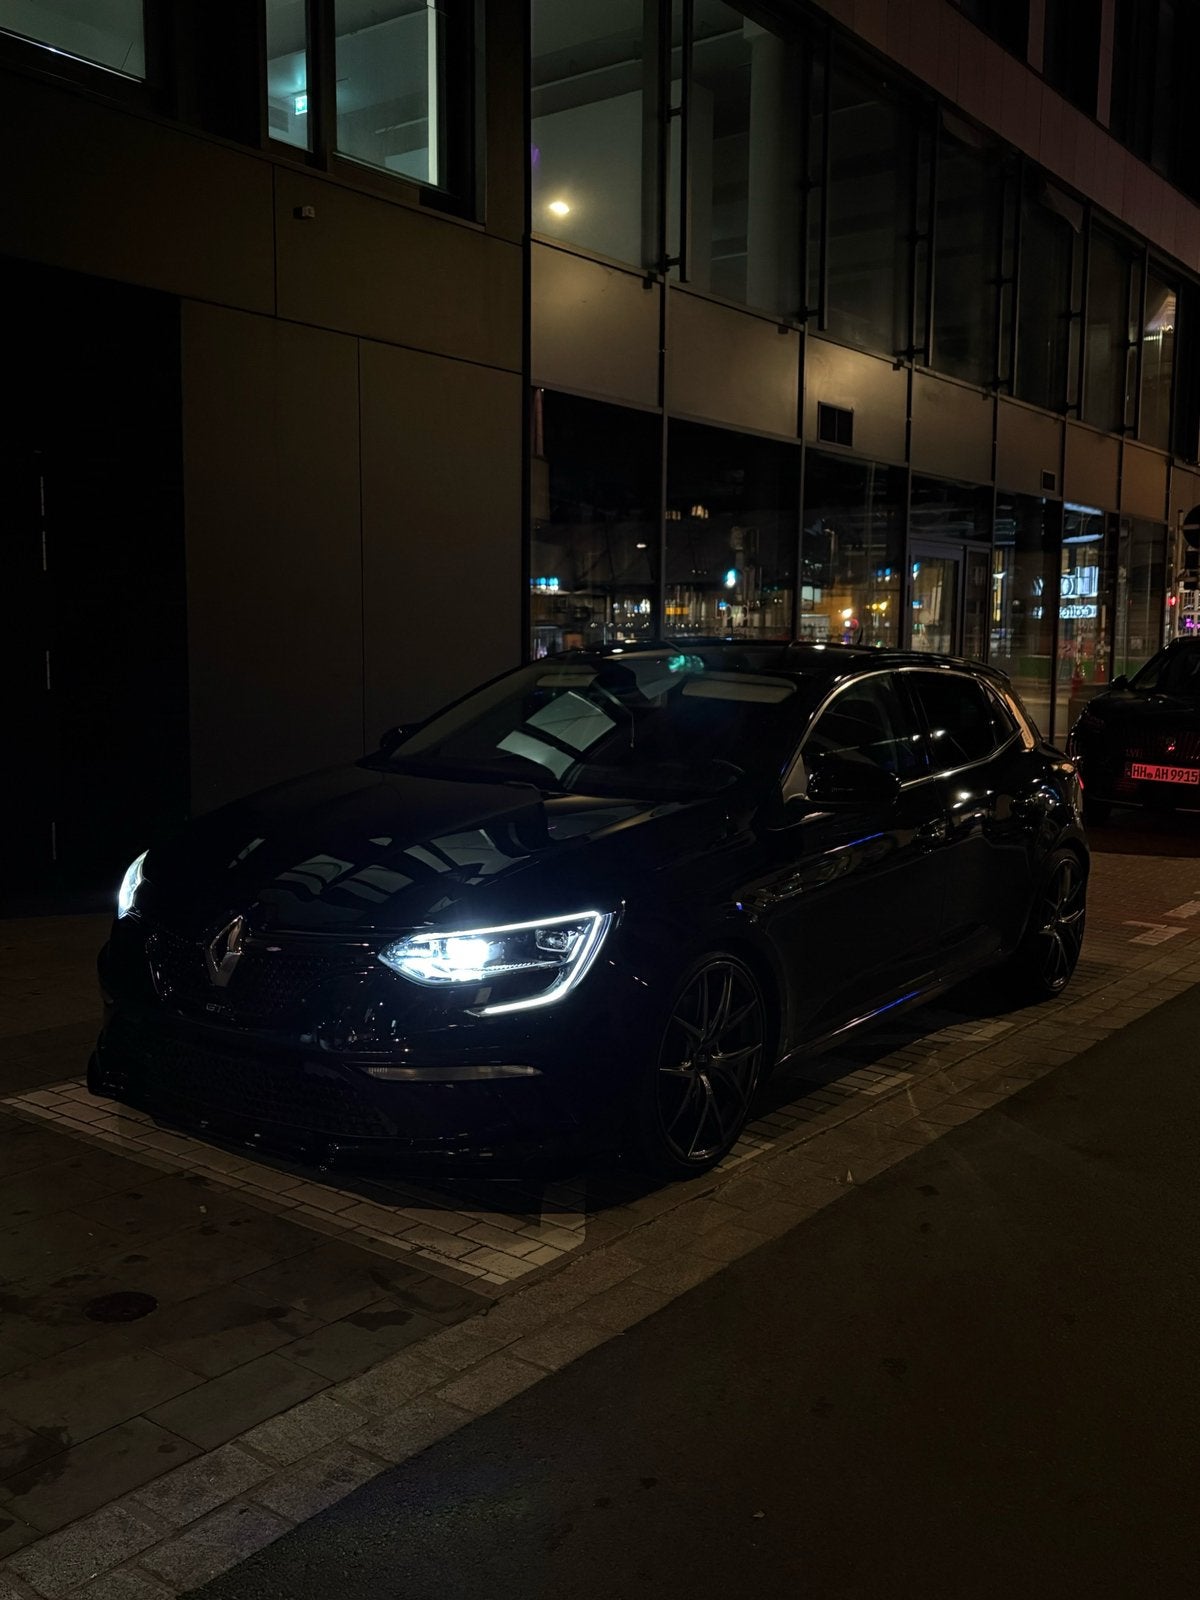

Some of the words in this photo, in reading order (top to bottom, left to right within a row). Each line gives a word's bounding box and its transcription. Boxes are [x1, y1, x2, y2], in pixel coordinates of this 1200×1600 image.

[1133, 765, 1147, 777] HH
[1154, 767, 1169, 780] AH
[1170, 769, 1198, 783] 9915
